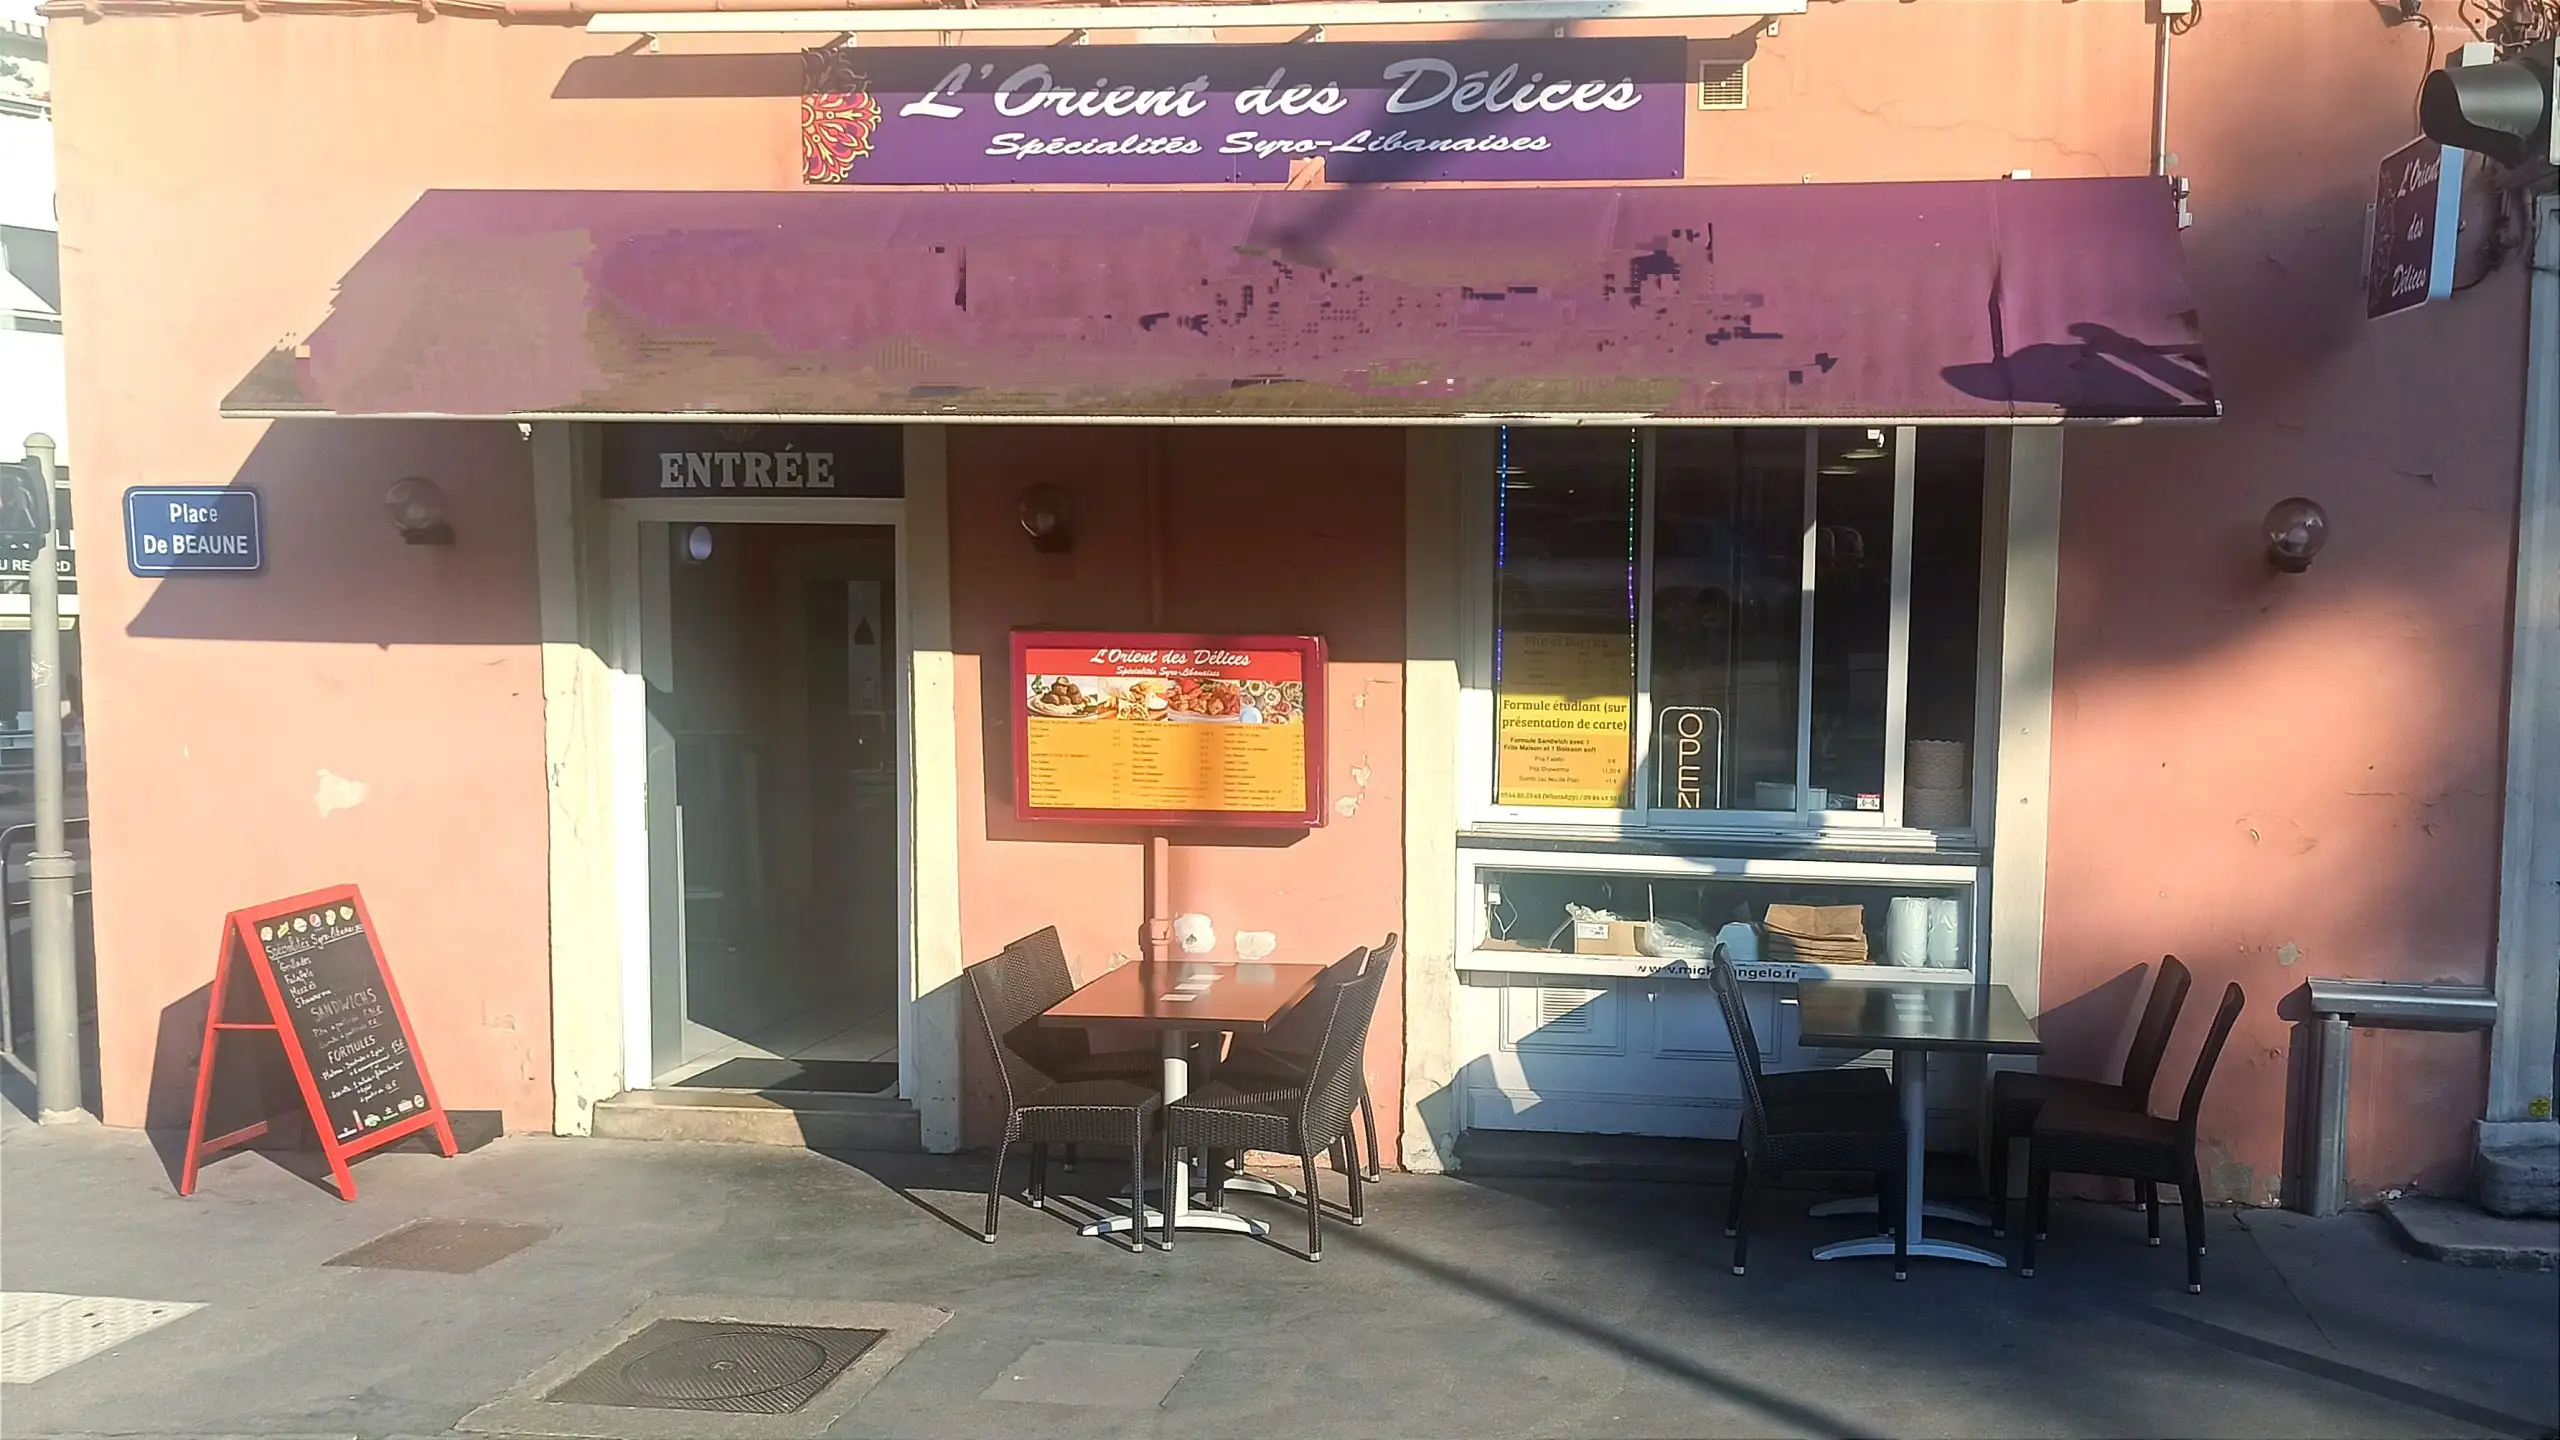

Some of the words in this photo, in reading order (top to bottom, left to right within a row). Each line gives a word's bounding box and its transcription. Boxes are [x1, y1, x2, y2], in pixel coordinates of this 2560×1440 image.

[899, 63, 1210, 118] L'Orient
[1234, 67, 1348, 115] des
[1383, 57, 1642, 114] Délices
[985, 132, 1202, 160] Spécialités
[1219, 129, 1552, 158] Syro-Libanaises
[2397, 156, 2440, 198] L'Orient
[2407, 213, 2423, 241] des
[2391, 264, 2427, 297] Délices
[660, 442, 834, 488] ENTRÉE
[169, 503, 218, 523] Place
[143, 535, 168, 554] De
[172, 535, 248, 554] BEAUNE
[12, 559, 71, 572] RED
[1089, 648, 1158, 664] L'Orient
[1162, 649, 1188, 664] des
[1194, 650, 1251, 666] Délices
[1116, 666, 1157, 675] Spécialités
[1158, 667, 1220, 677] Syro-Libanaises
[1503, 699, 1551, 710] Formule
[1553, 700, 1601, 712] étudiant
[1604, 702, 1627, 714] (sur
[1502, 716, 1574, 730] présentation
[1577, 719, 1591, 729] de
[1593, 720, 1627, 731] carte)
[1678, 713, 1703, 808] OPEN
[327, 1034, 376, 1064] FORMULES
